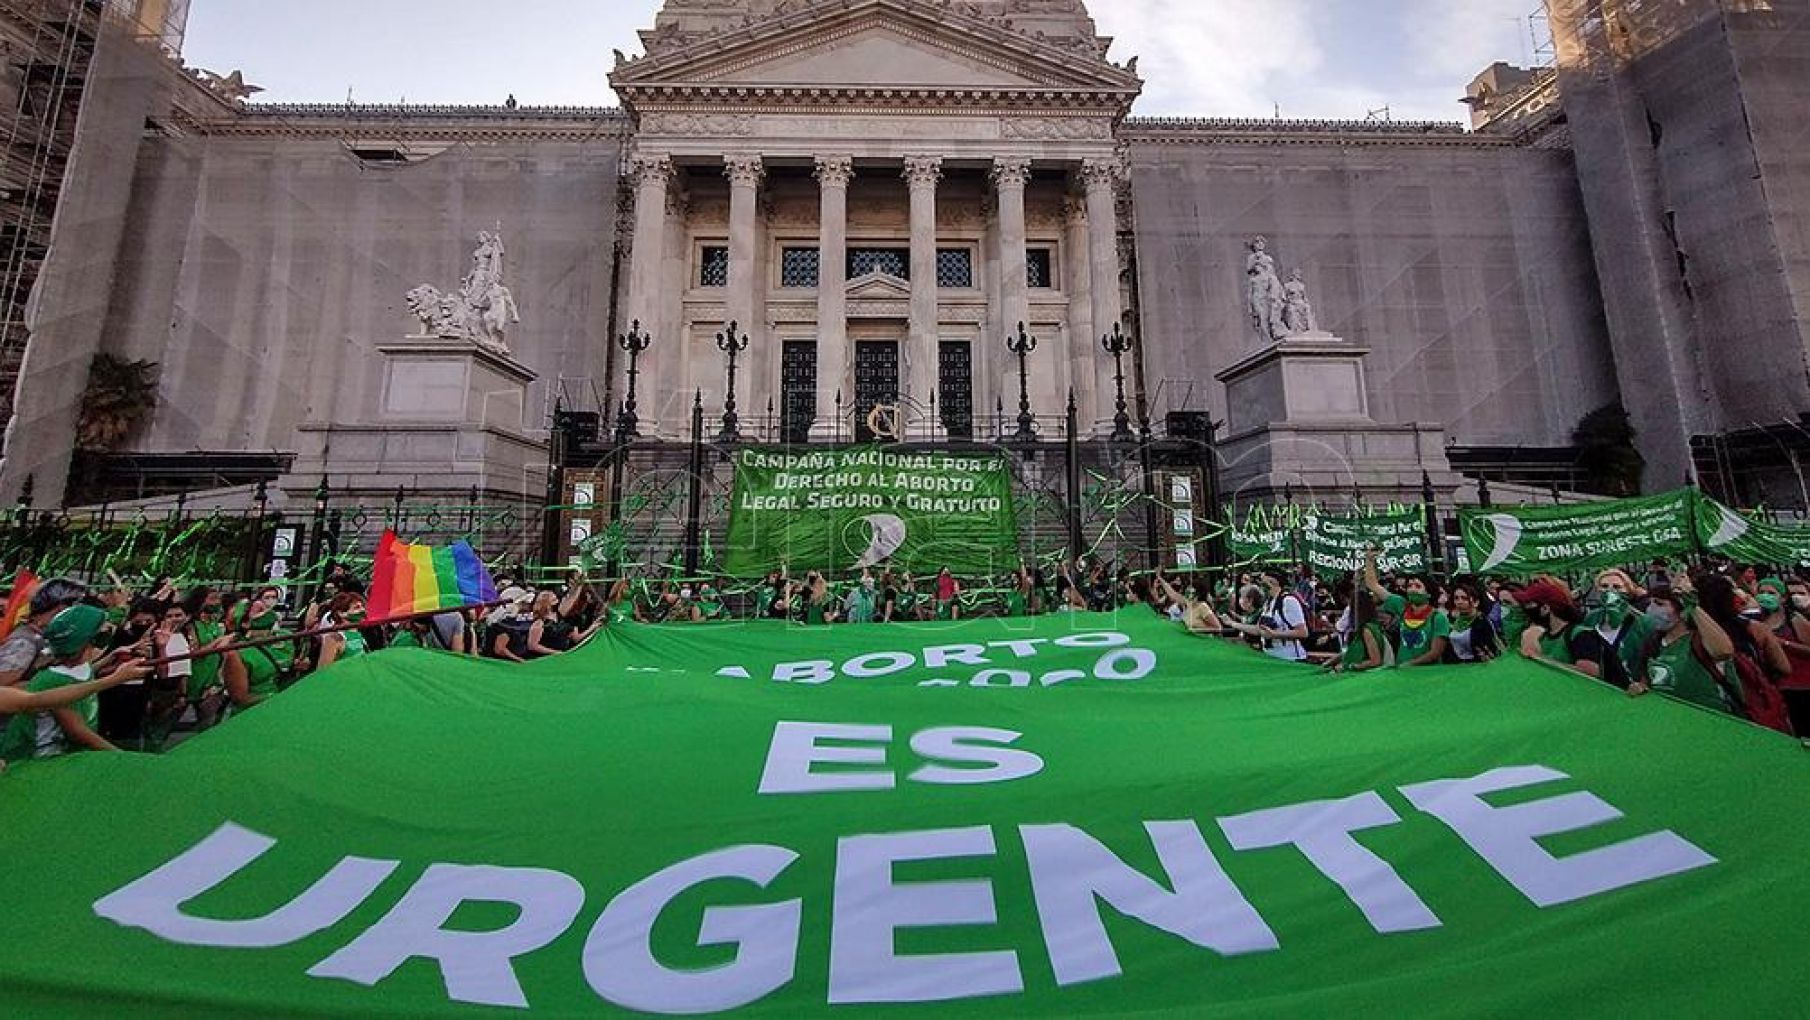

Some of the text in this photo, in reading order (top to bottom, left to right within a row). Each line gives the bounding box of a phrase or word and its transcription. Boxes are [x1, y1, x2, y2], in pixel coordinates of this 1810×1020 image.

[943, 458, 981, 471] POR
[774, 472, 974, 492] DERECHO AL ABORTO
[741, 490, 1000, 512] LEGAL SEGURO Y GRATUITO
[1309, 550, 1367, 572] REGIONA
[1536, 543, 1584, 560] ZONA
[758, 720, 1045, 795] ES
[91, 764, 1720, 1015] URGENTE
